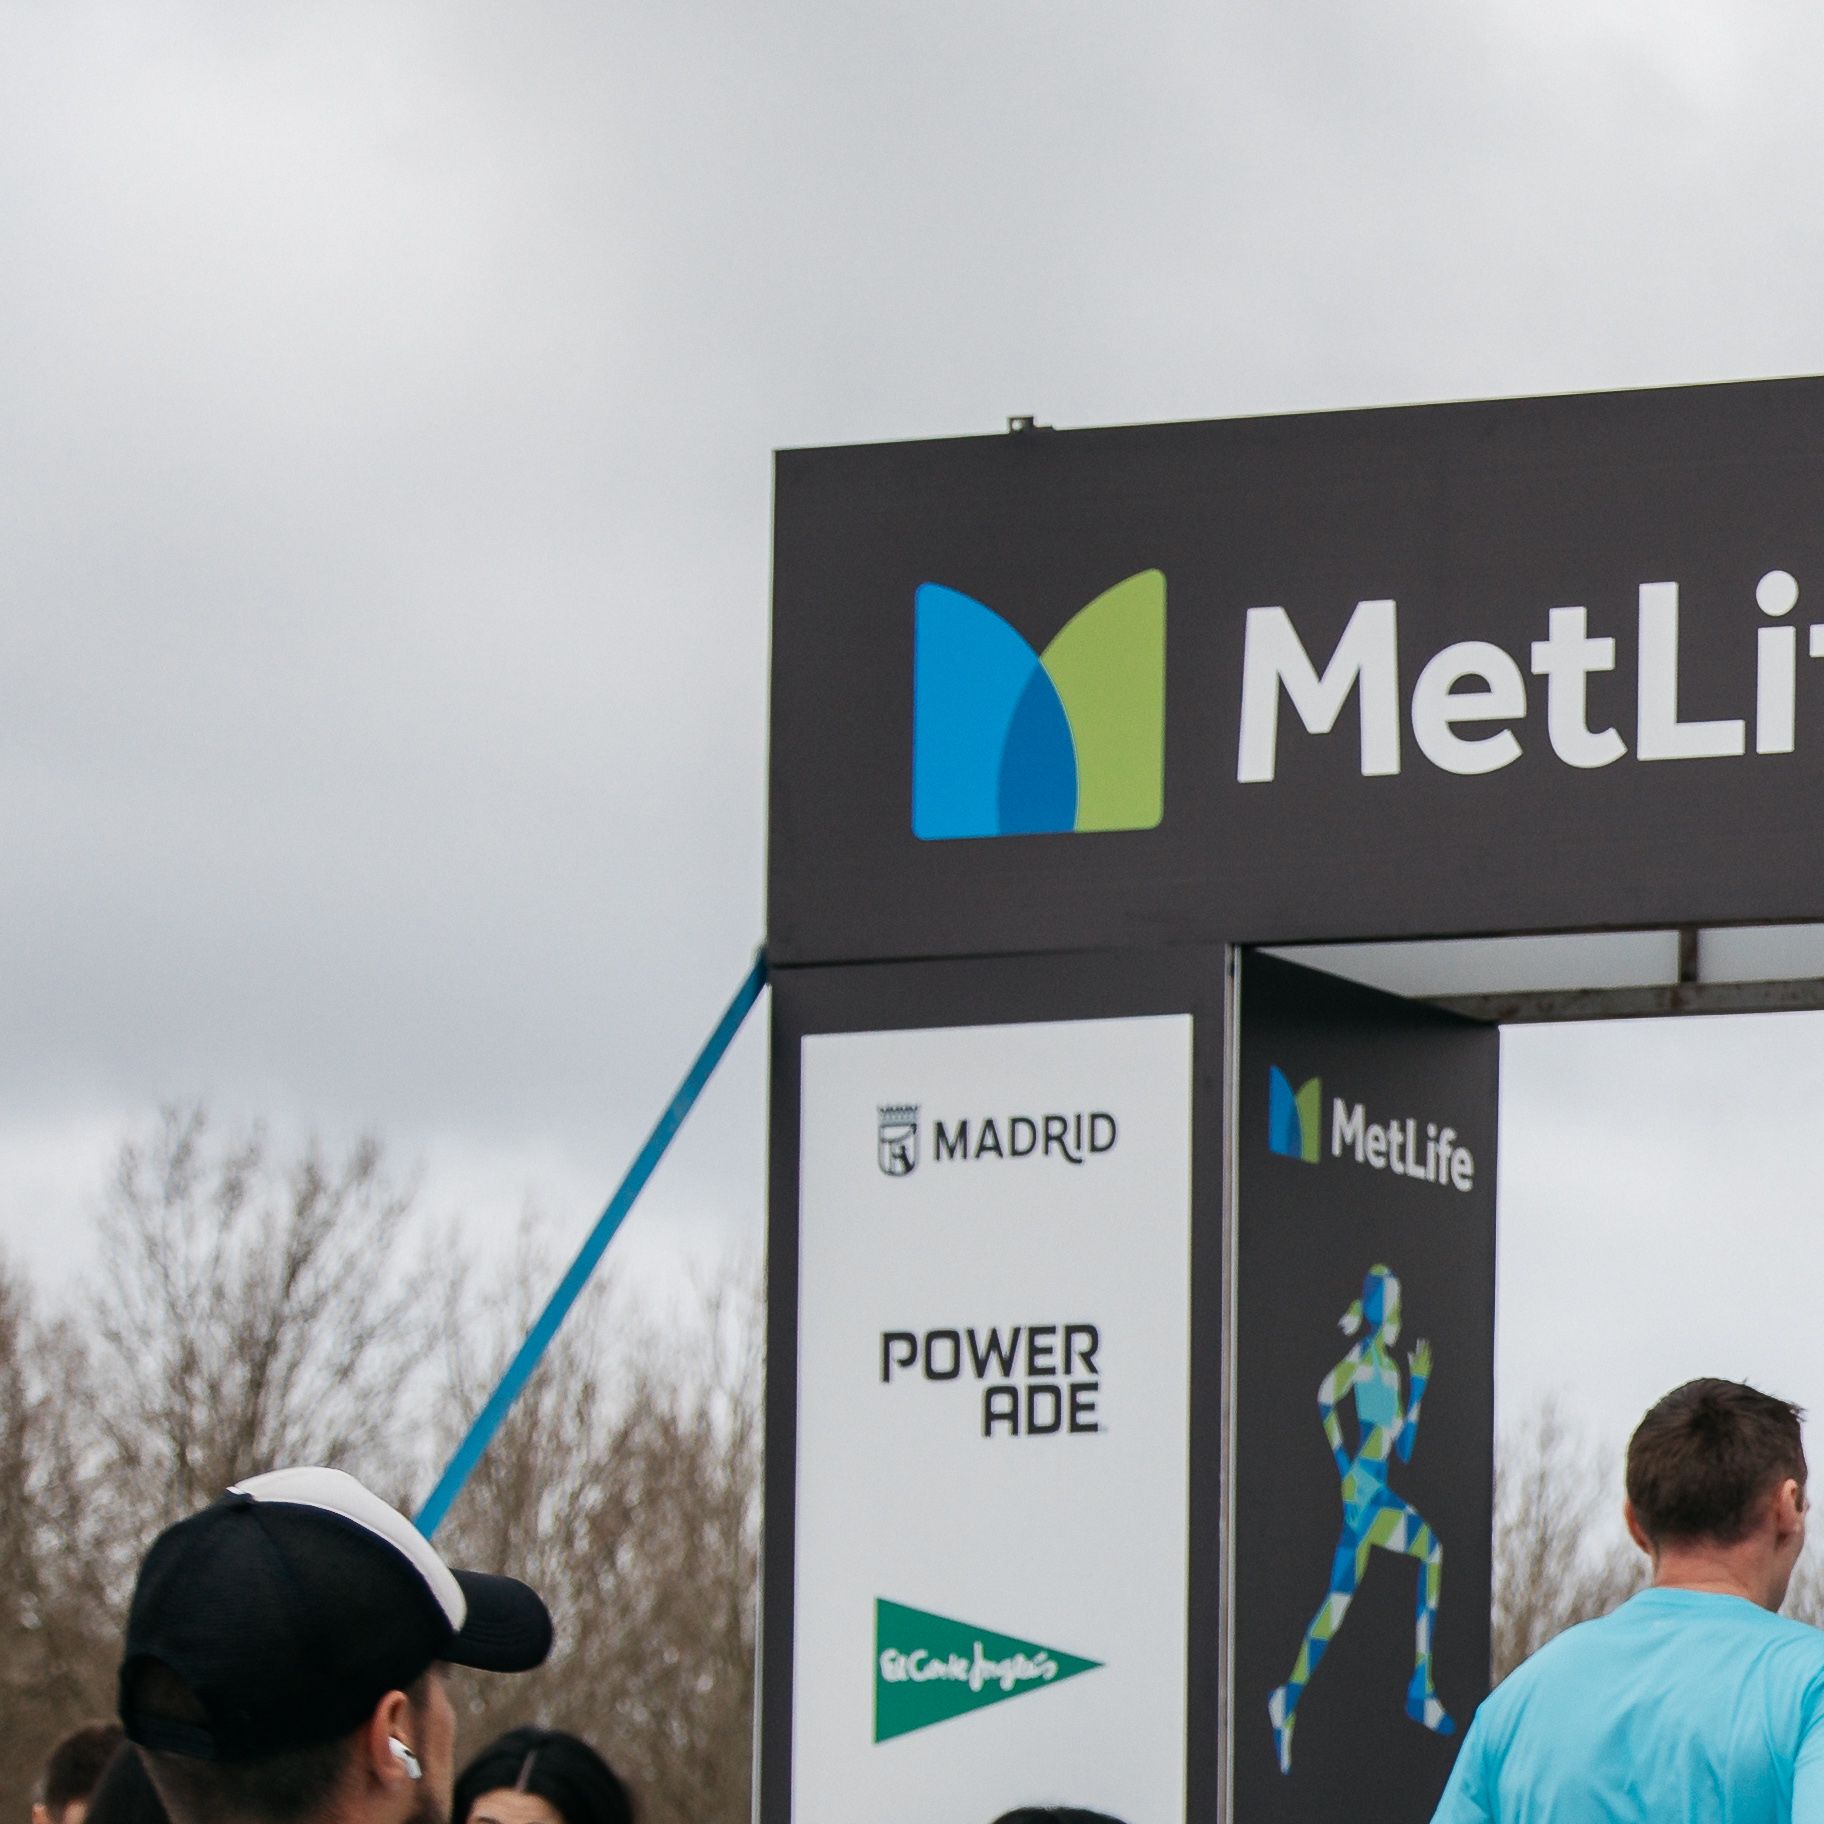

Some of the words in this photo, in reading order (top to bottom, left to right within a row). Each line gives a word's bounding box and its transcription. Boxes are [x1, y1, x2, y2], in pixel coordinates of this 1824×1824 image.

[932, 1110, 1118, 1164] MADRID
[1331, 1096, 1475, 1193] MetLife
[880, 1323, 1101, 1383] POWER
[982, 1382, 1101, 1438] ADE
[880, 1648, 909, 1683] El
